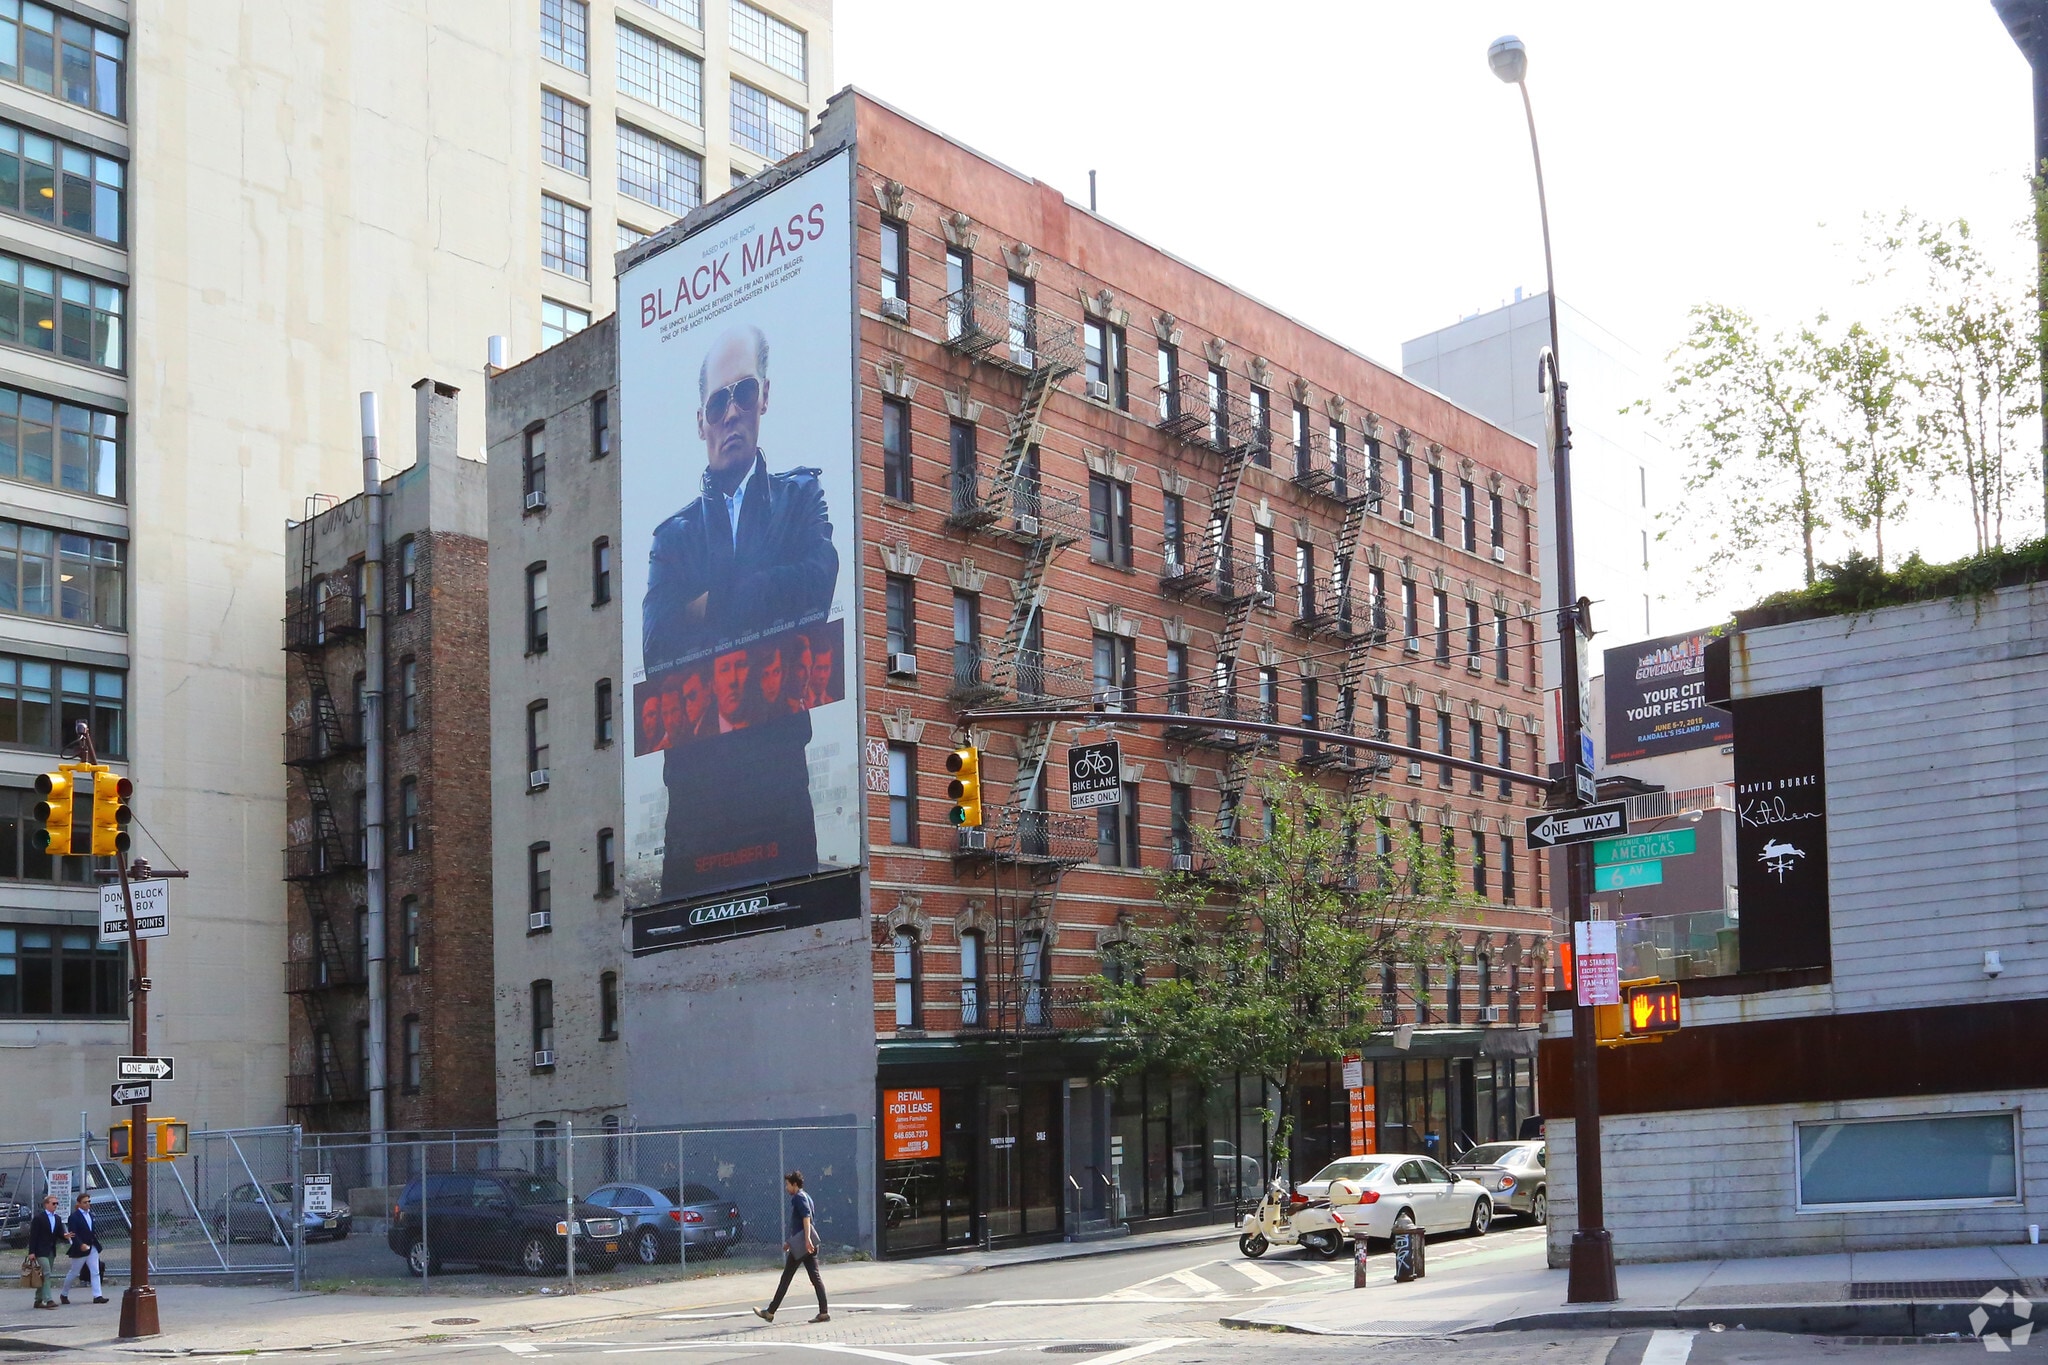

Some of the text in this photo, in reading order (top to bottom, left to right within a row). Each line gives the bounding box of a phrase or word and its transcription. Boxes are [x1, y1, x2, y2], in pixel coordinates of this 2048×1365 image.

[702, 224, 755, 258] BASED ON THE BOOK
[641, 204, 825, 328] BLACK MASS
[660, 325, 668, 333] THE
[669, 314, 687, 329] UNHOLY
[688, 304, 710, 319] ALLIANCE
[712, 292, 733, 308] BETWEEN
[734, 286, 742, 296] THE
[752, 276, 763, 287] AND
[765, 266, 782, 280] WHITEY
[661, 333, 671, 343] ONE
[672, 329, 679, 338] OF
[680, 325, 688, 334] THE
[690, 317, 704, 329] MOST
[704, 302, 733, 321] NOTORIOUS
[734, 286, 763, 306] GANGSTERS
[764, 284, 770, 292] IN
[780, 267, 801, 284] HISTORY
[1636, 658, 1693, 679] GOVERNORS
[1644, 681, 1705, 704] YOUR CIT
[1627, 705, 1661, 721] YOUR
[1638, 722, 1720, 742] RANDALL'S ISLAND PARK
[1654, 722, 1671, 732] JUNE
[1072, 776, 1117, 791] BIKE LANE
[1740, 775, 1816, 794] DAVID BURKE
[1073, 791, 1118, 805] BIKES ONLY
[1738, 796, 1823, 828] Kitchen
[1542, 814, 1614, 837] ONE WAY
[1611, 841, 1675, 860] AMERICAS
[1616, 838, 1640, 847] AVENUE
[695, 842, 778, 873] SEPTEMBER 18
[1611, 864, 1643, 886] 6 AV
[105, 888, 163, 902] DON BLOCK
[114, 900, 154, 912] TH BOX
[696, 900, 760, 922] LAMAR
[106, 922, 122, 932] FINE
[137, 918, 163, 928] POINTS
[1660, 994, 1677, 1022] 11
[126, 1064, 165, 1073] ONE WAY
[117, 1088, 147, 1099] ONE WAY
[898, 1091, 925, 1101] RETAIL
[1350, 1091, 1366, 1100] Retal
[890, 1103, 932, 1114] FOR LEASE
[1350, 1103, 1375, 1113] for Lase
